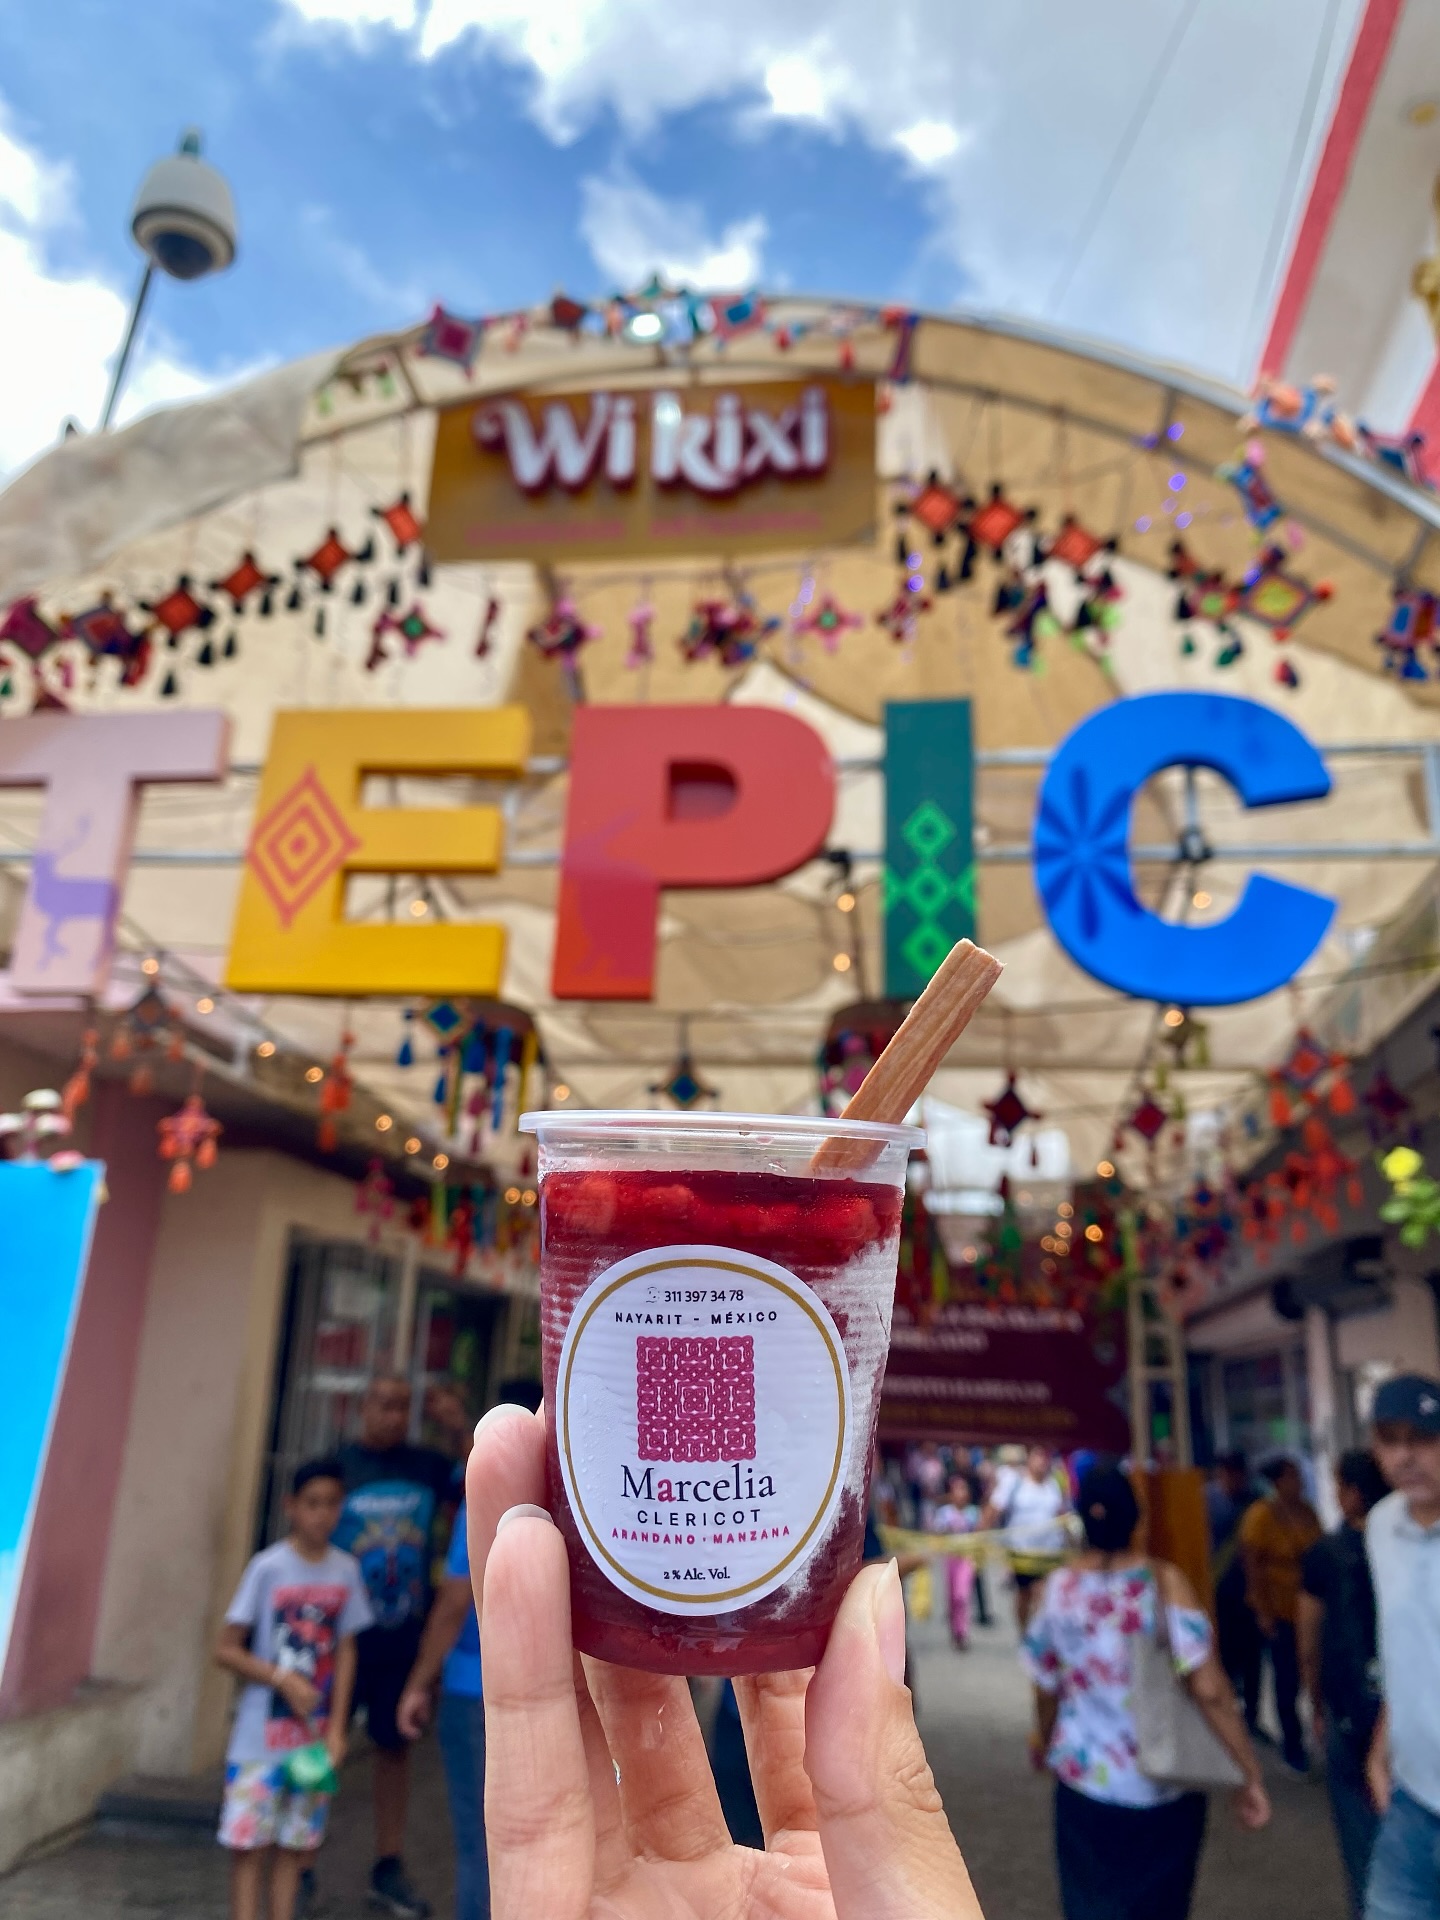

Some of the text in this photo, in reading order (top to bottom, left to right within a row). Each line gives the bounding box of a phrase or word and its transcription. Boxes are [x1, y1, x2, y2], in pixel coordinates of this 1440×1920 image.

[0, 690, 1338, 1006] TEPIC
[664, 1289, 744, 1302] 311 397 34 78
[615, 1312, 682, 1325] NAYARIT
[711, 1311, 777, 1324] MÉXICO
[620, 1463, 777, 1503] Marcelia
[637, 1509, 761, 1526] CLERICOT
[612, 1527, 696, 1545] ARANDANO
[713, 1525, 790, 1544] MANZANA
[663, 1571, 670, 1580] 2
[683, 1568, 706, 1581] Alc.
[708, 1566, 731, 1580] Vol.
